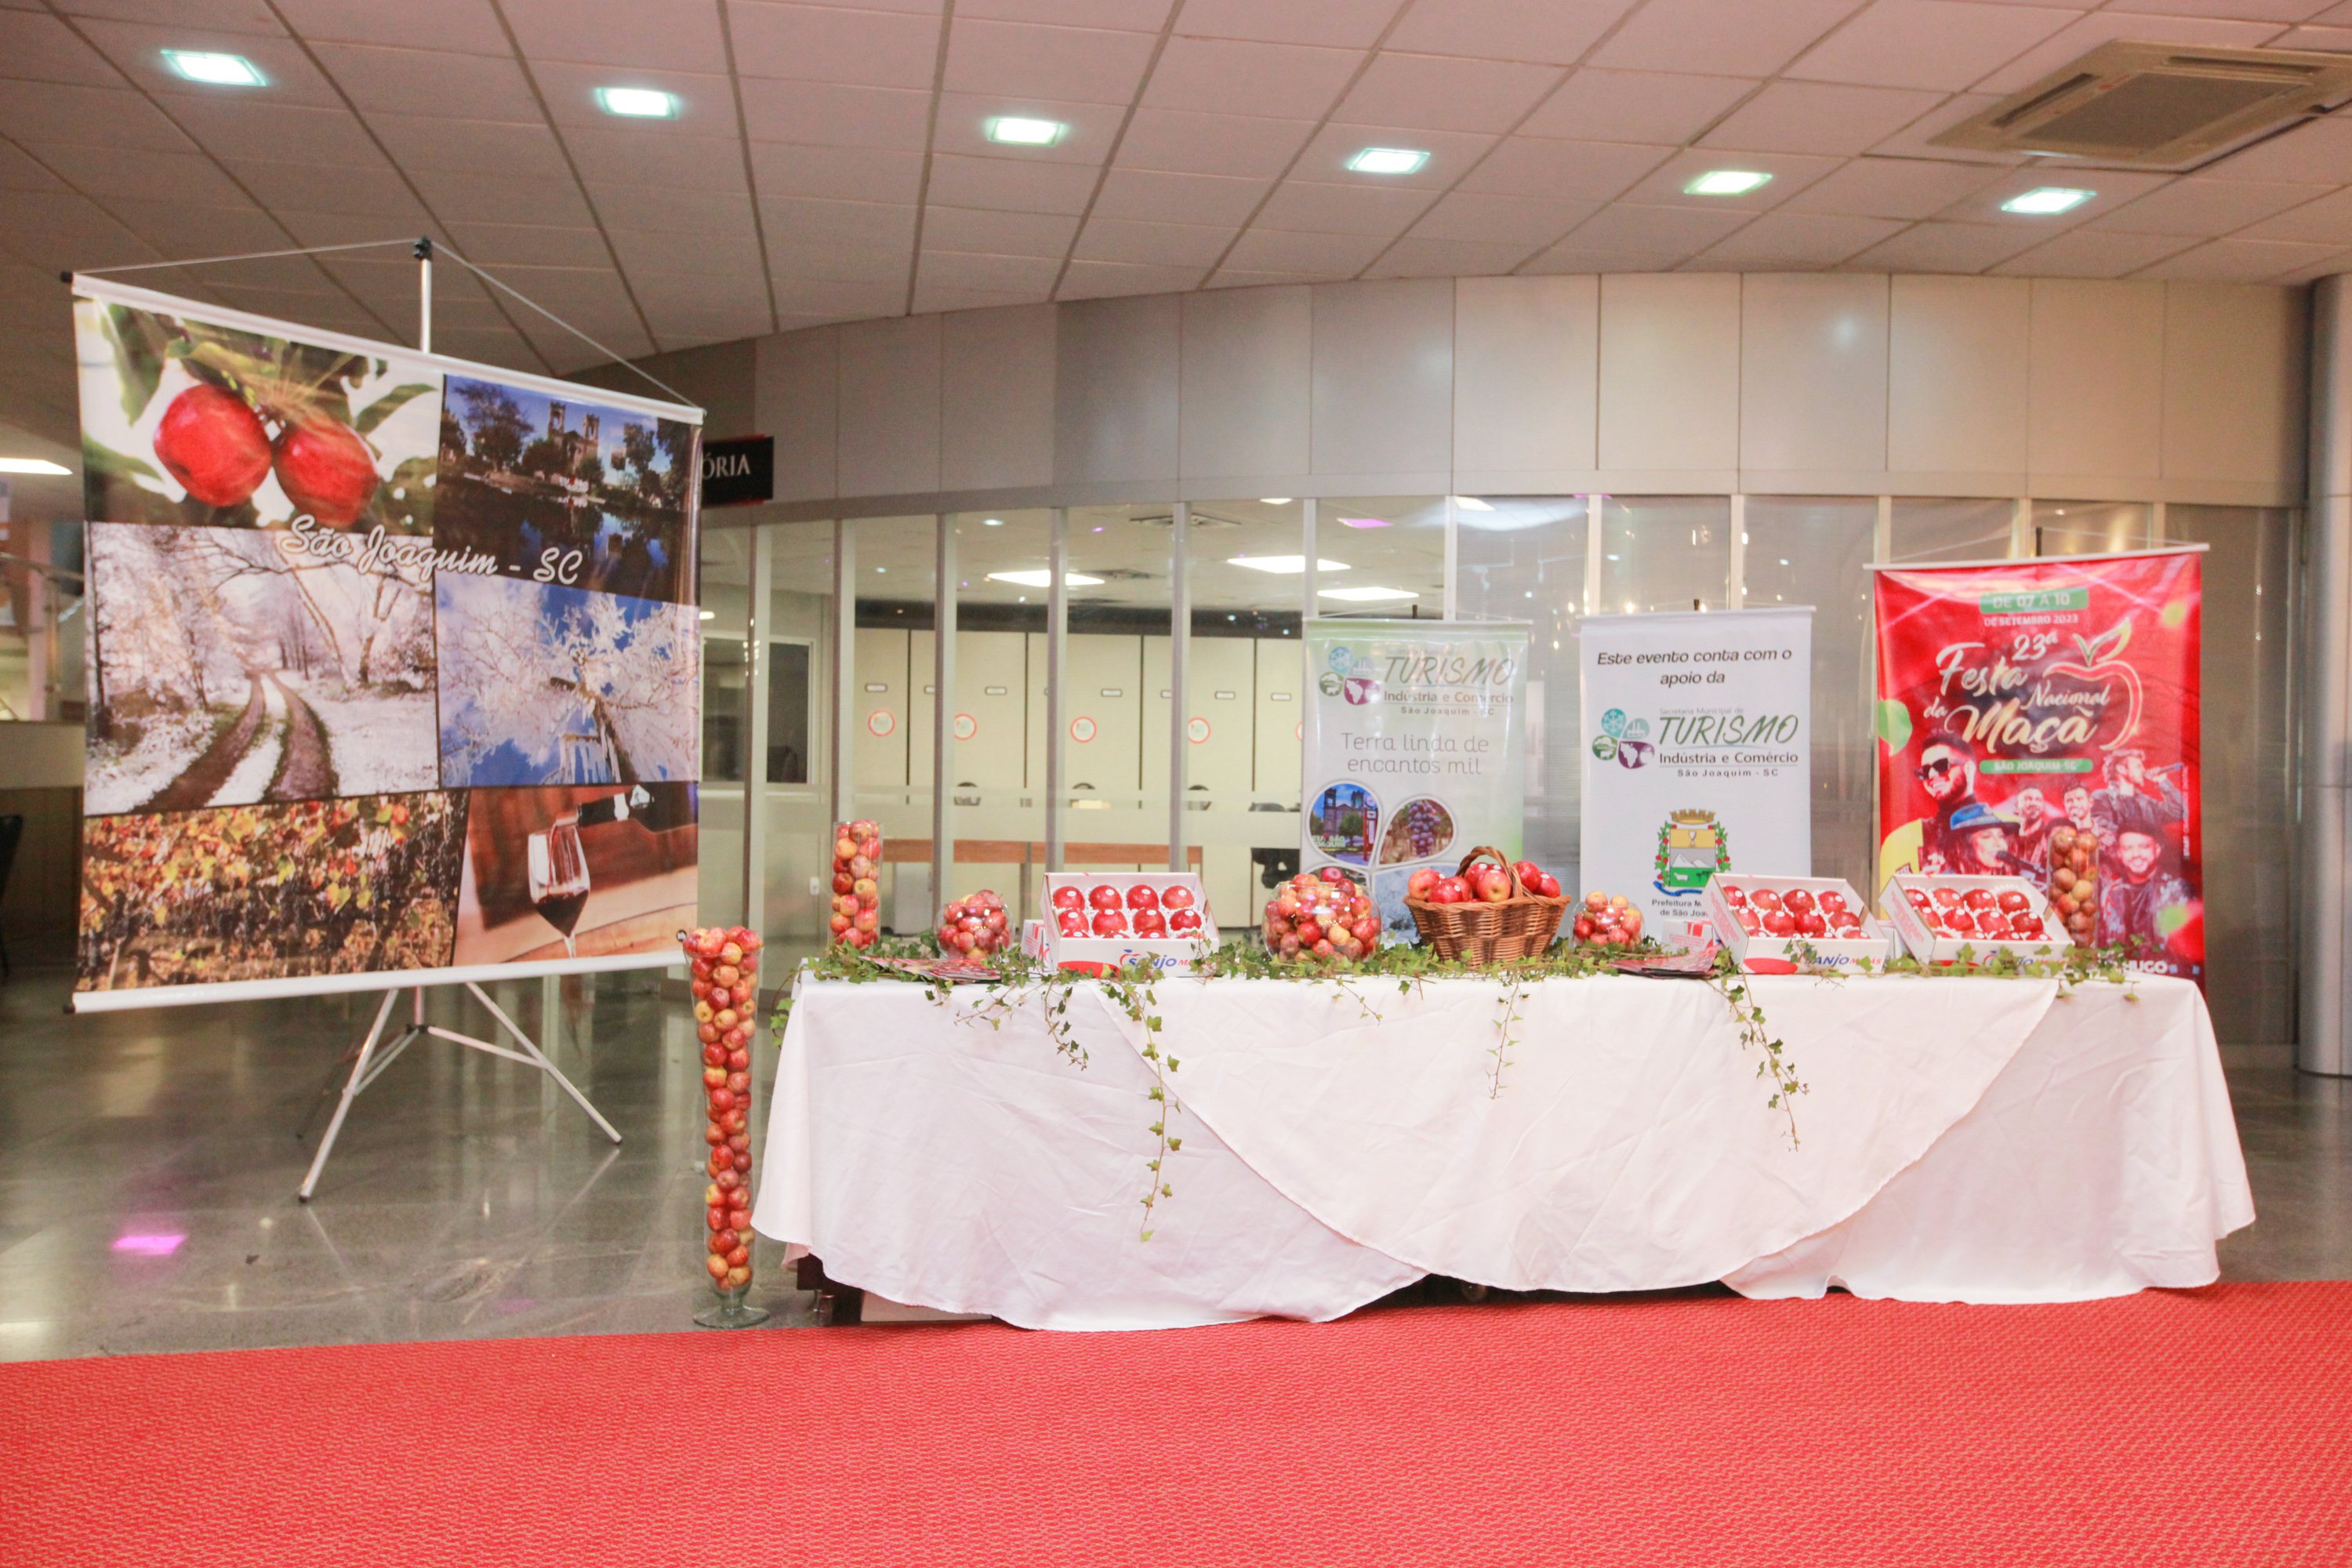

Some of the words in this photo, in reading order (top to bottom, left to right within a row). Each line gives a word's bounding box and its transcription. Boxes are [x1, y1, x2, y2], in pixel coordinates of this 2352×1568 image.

[702, 452, 751, 479] ÓRIA
[279, 514, 352, 557] São
[357, 524, 499, 582] Joaquim
[532, 547, 583, 585] SC
[1992, 597, 2013, 608] DE
[2016, 594, 2036, 608] 07
[2039, 593, 2050, 606] A
[2055, 592, 2071, 605] 10
[1984, 616, 1997, 626] DE
[1999, 615, 2051, 626] SETEMBRO
[2053, 614, 2078, 624] 2023
[1598, 652, 1632, 665] Este
[1636, 652, 1689, 664] evento
[1693, 650, 1739, 662] conta
[1744, 650, 1777, 661] com
[1782, 649, 1792, 660] o
[1385, 656, 1515, 685] TURISMO
[1936, 641, 2029, 697] Festa
[1660, 671, 1701, 688] apoio
[1707, 670, 1726, 684] da
[1385, 690, 1437, 702] Indústria
[1443, 693, 1450, 702] e
[2020, 679, 2111, 711] Nacional
[1424, 707, 1470, 716] Joaquim
[1697, 707, 1732, 717] Municipal
[1659, 714, 1799, 745] TURISMO
[1923, 696, 1948, 718] da
[1944, 697, 2099, 753] Maçã
[1341, 733, 1396, 750] Terra
[1403, 735, 1458, 752] linda
[1464, 735, 1489, 753] de
[1348, 758, 1441, 774] encantos
[1448, 757, 1482, 775] mil
[1660, 752, 1716, 764] Indústria
[1722, 754, 1730, 764] e
[1734, 750, 1799, 763] Comércio
[1994, 760, 2014, 771] SÃO
[1678, 768, 1698, 777] São
[1702, 768, 1751, 778] Joaquim
